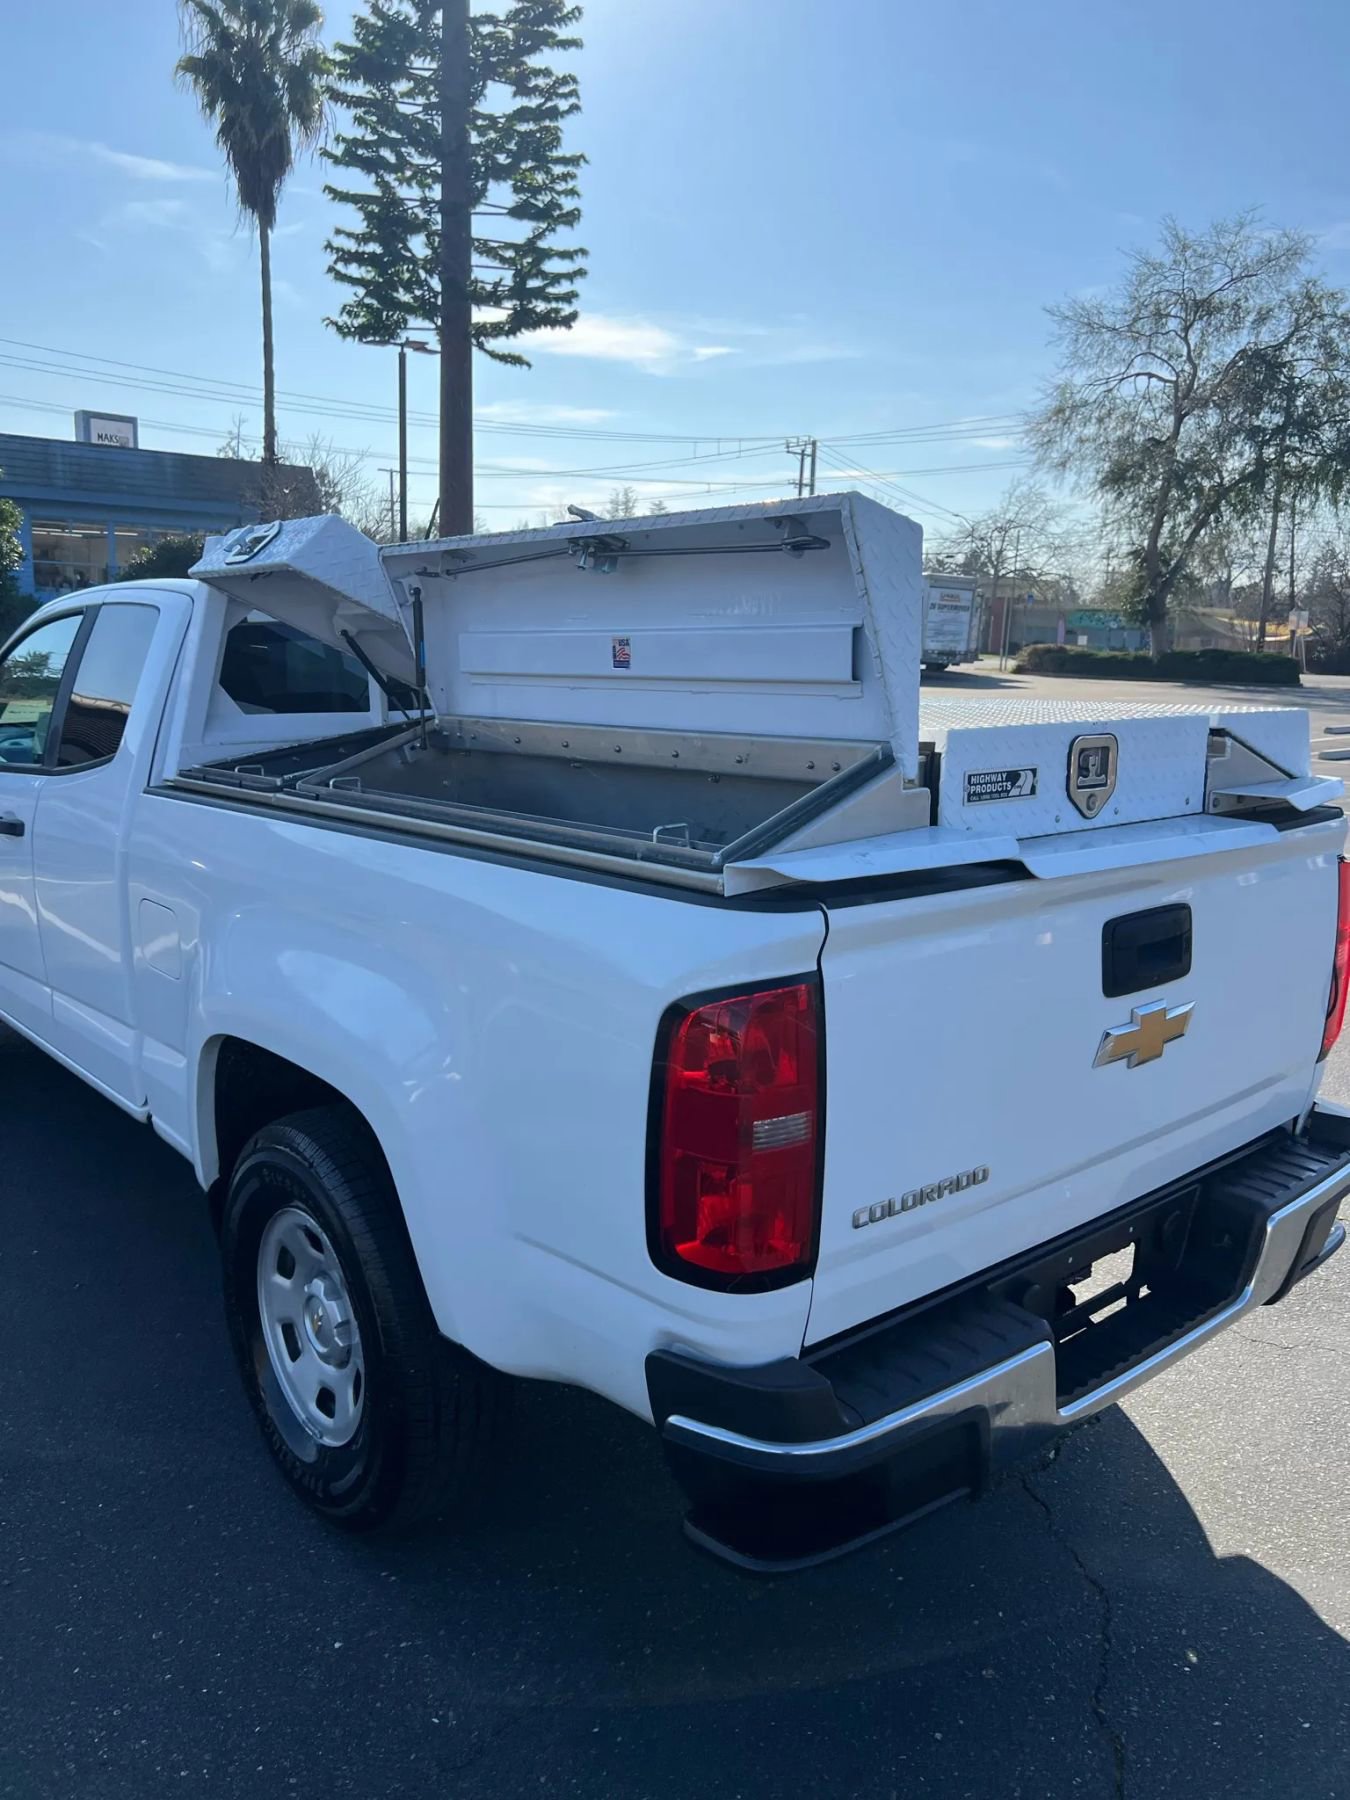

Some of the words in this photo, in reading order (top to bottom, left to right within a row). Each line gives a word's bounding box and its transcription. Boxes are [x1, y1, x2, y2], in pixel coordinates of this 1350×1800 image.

[970, 772, 1008, 785] HIGHWAY
[970, 781, 1012, 794] PRODUCTS
[852, 1165, 990, 1229] COLORADO
